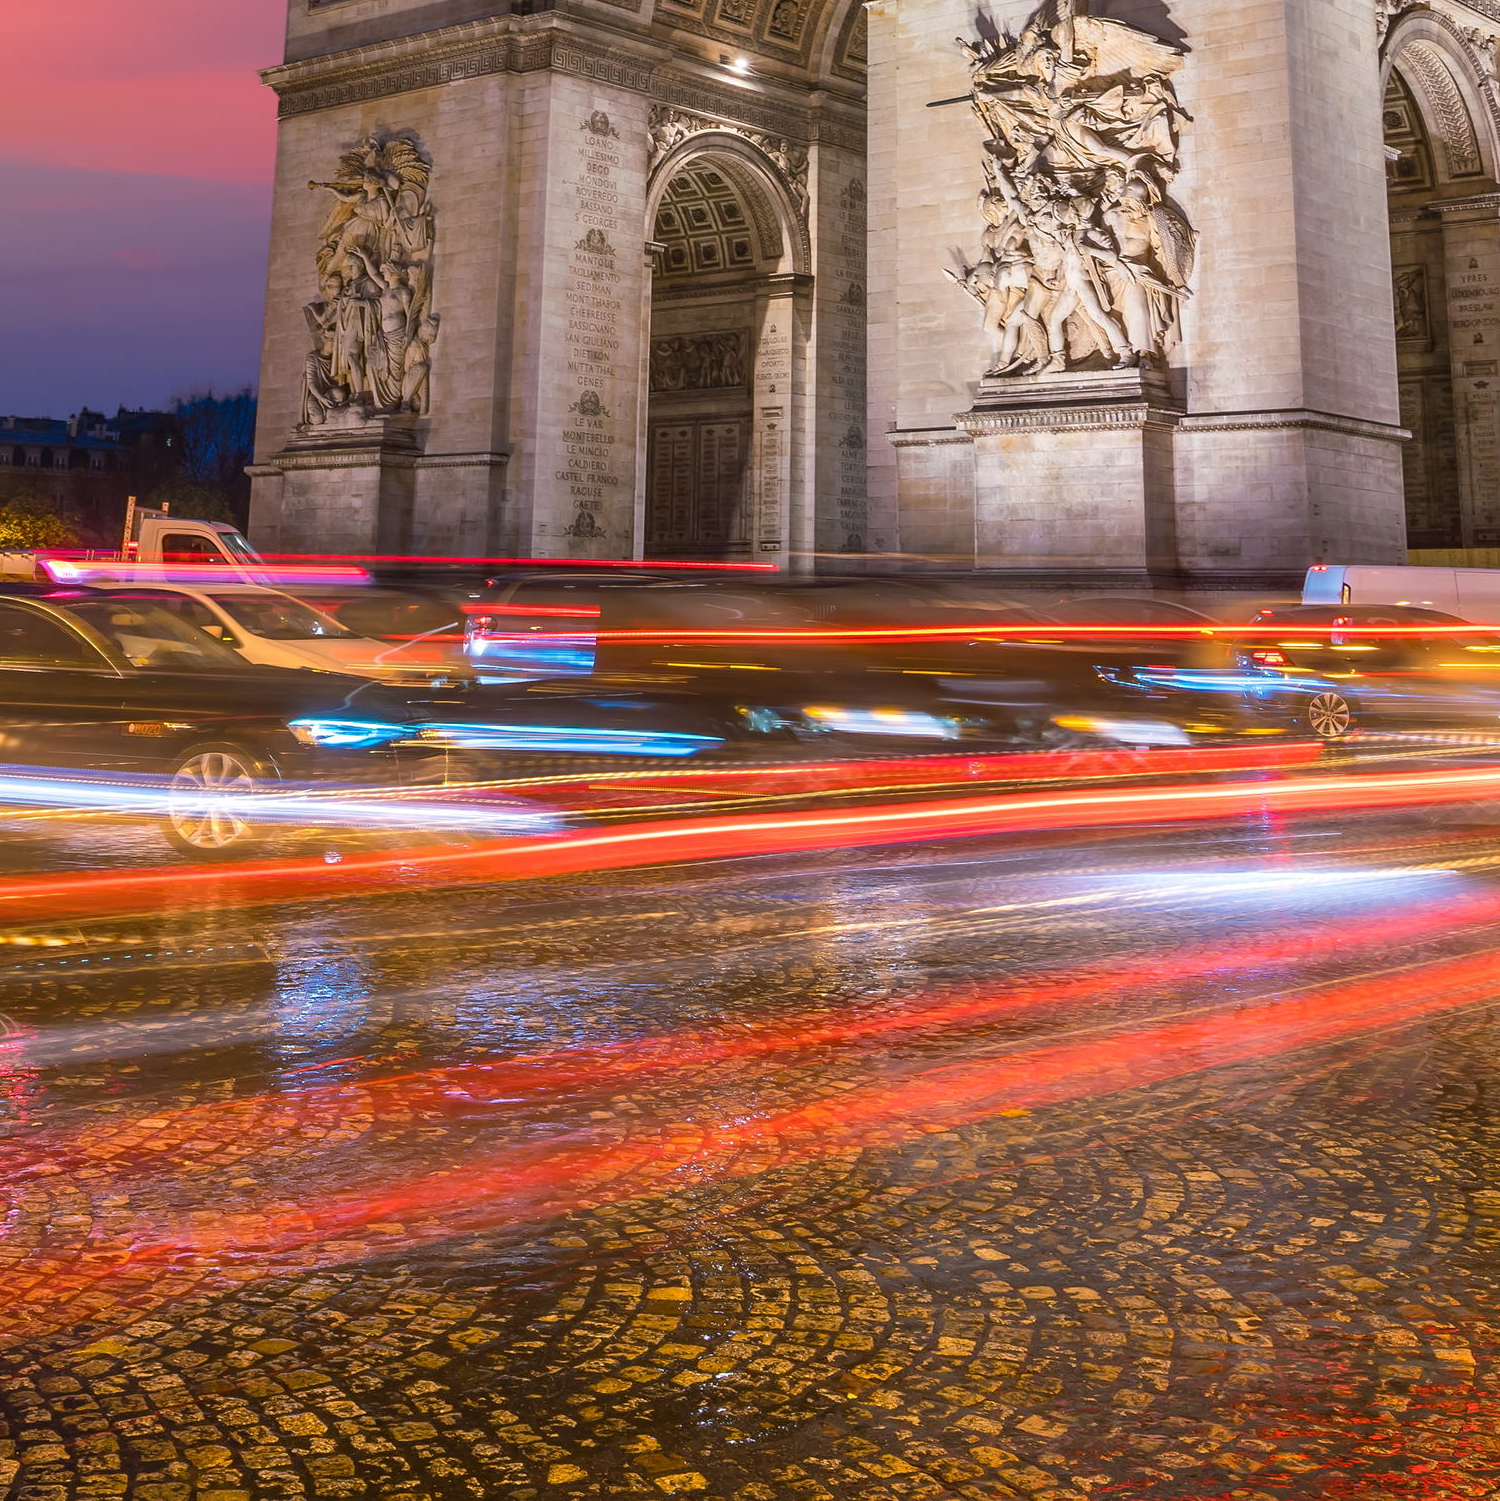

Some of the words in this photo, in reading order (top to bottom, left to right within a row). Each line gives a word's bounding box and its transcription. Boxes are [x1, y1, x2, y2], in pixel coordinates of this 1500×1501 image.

[584, 135, 614, 150] LOANO
[578, 148, 620, 165] MILLESIMO
[586, 163, 610, 176] DEGO
[578, 174, 617, 190] MONDOVI
[576, 186, 618, 203] ROVEREDO
[580, 200, 613, 215] BASSANO
[582, 214, 618, 229] GEORGES
[844, 224, 867, 236] BURGO
[575, 253, 614, 270] MANTOUE
[568, 265, 620, 283] TAGLIAMENTO
[1460, 273, 1488, 283] YPRES
[576, 281, 612, 295] SEDIMAN
[1452, 287, 1500, 299] LUXEMBOURG
[566, 293, 589, 304] MONT
[591, 297, 622, 311] THABOR
[1459, 303, 1494, 313] BRESLAW
[570, 307, 616, 323] CHEBREISSE
[836, 305, 867, 317] SARRAGO
[568, 320, 616, 335] BASSIGNANO
[564, 333, 580, 343] SAN
[582, 336, 619, 349] GIULIANO
[574, 347, 610, 361] DIETIKON
[568, 361, 594, 373] MUTTA
[596, 365, 615, 376] THAL
[577, 376, 604, 388] GENES
[575, 417, 584, 427] LE
[587, 419, 604, 429] VAR
[562, 430, 614, 445] MONTEBELLO
[566, 444, 576, 454] LE
[580, 446, 609, 457] MINCIO
[568, 459, 606, 471] CALDIERO
[555, 471, 584, 482] CASTEL
[586, 473, 618, 485] FRANCO
[570, 485, 602, 497] RAGUSE
[573, 499, 600, 511] GAETE
